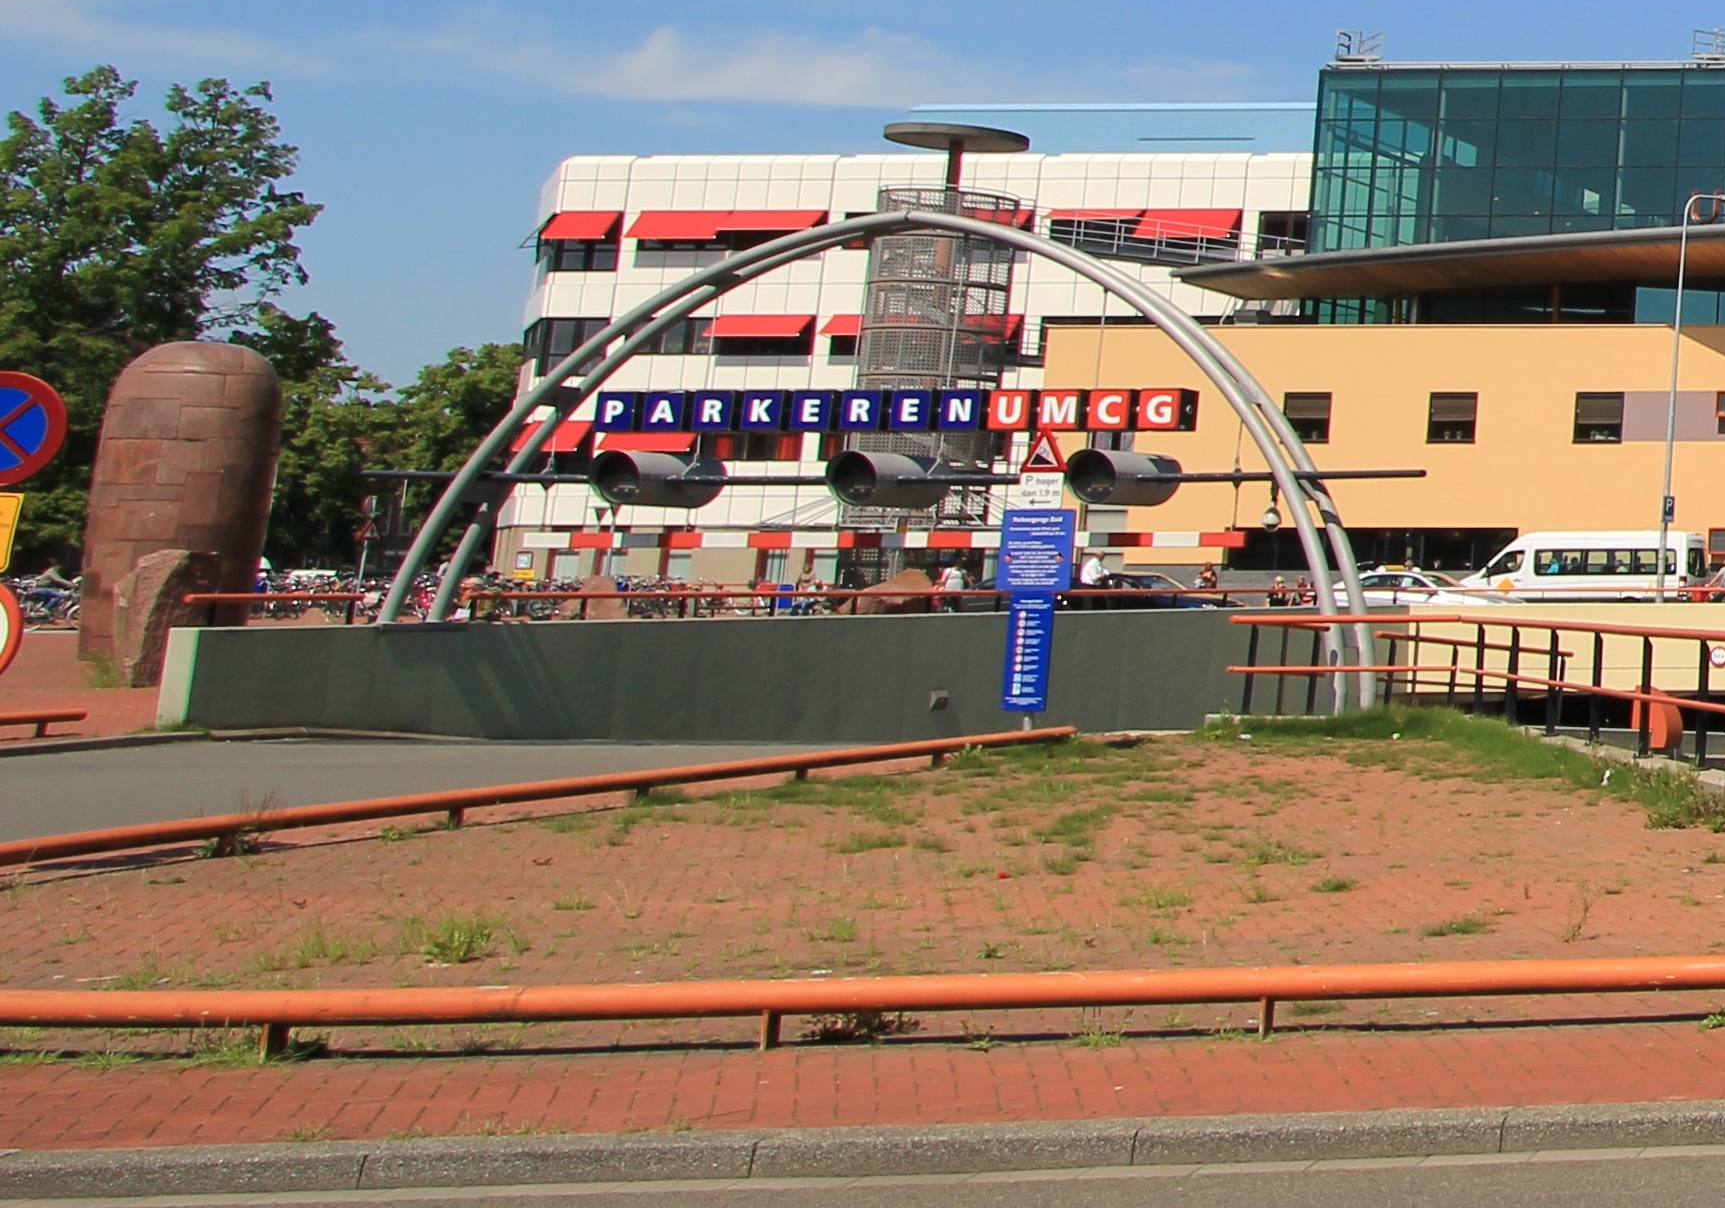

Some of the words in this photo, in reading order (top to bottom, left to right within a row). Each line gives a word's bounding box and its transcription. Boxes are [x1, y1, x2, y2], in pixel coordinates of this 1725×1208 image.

[603, 397, 974, 424] PARKEREN
[996, 394, 1174, 424] UMCG
[1025, 475, 1034, 485] P
[1036, 477, 1060, 488] hoger
[1666, 498, 1673, 511] P
